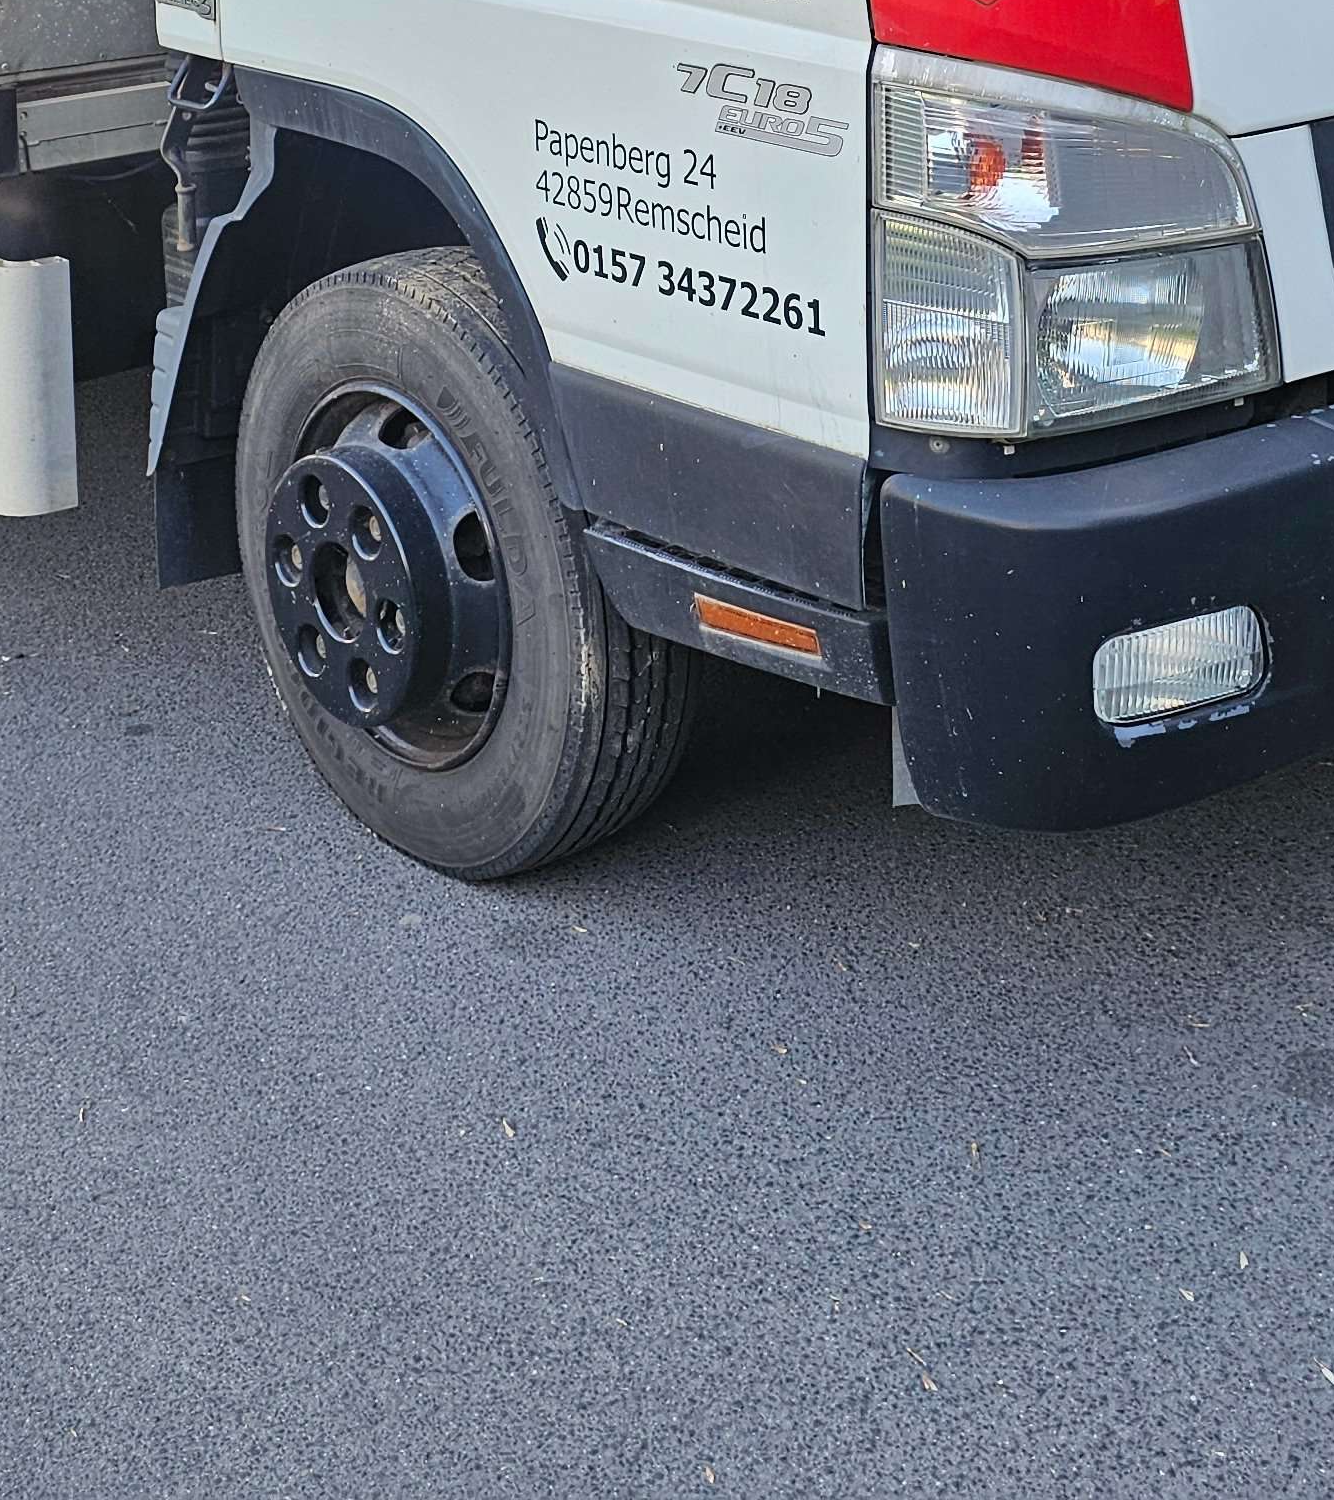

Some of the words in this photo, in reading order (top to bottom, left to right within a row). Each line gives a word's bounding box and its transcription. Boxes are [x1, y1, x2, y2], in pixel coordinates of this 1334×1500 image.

[677, 63, 812, 115] 7C18
[534, 119, 671, 187] Papenberg
[683, 148, 717, 190] 24
[535, 170, 612, 217] 42859
[617, 186, 766, 254] Remscheid
[573, 239, 646, 287] 0157
[658, 261, 826, 337] 34372261
[461, 435, 536, 627] FULDA
